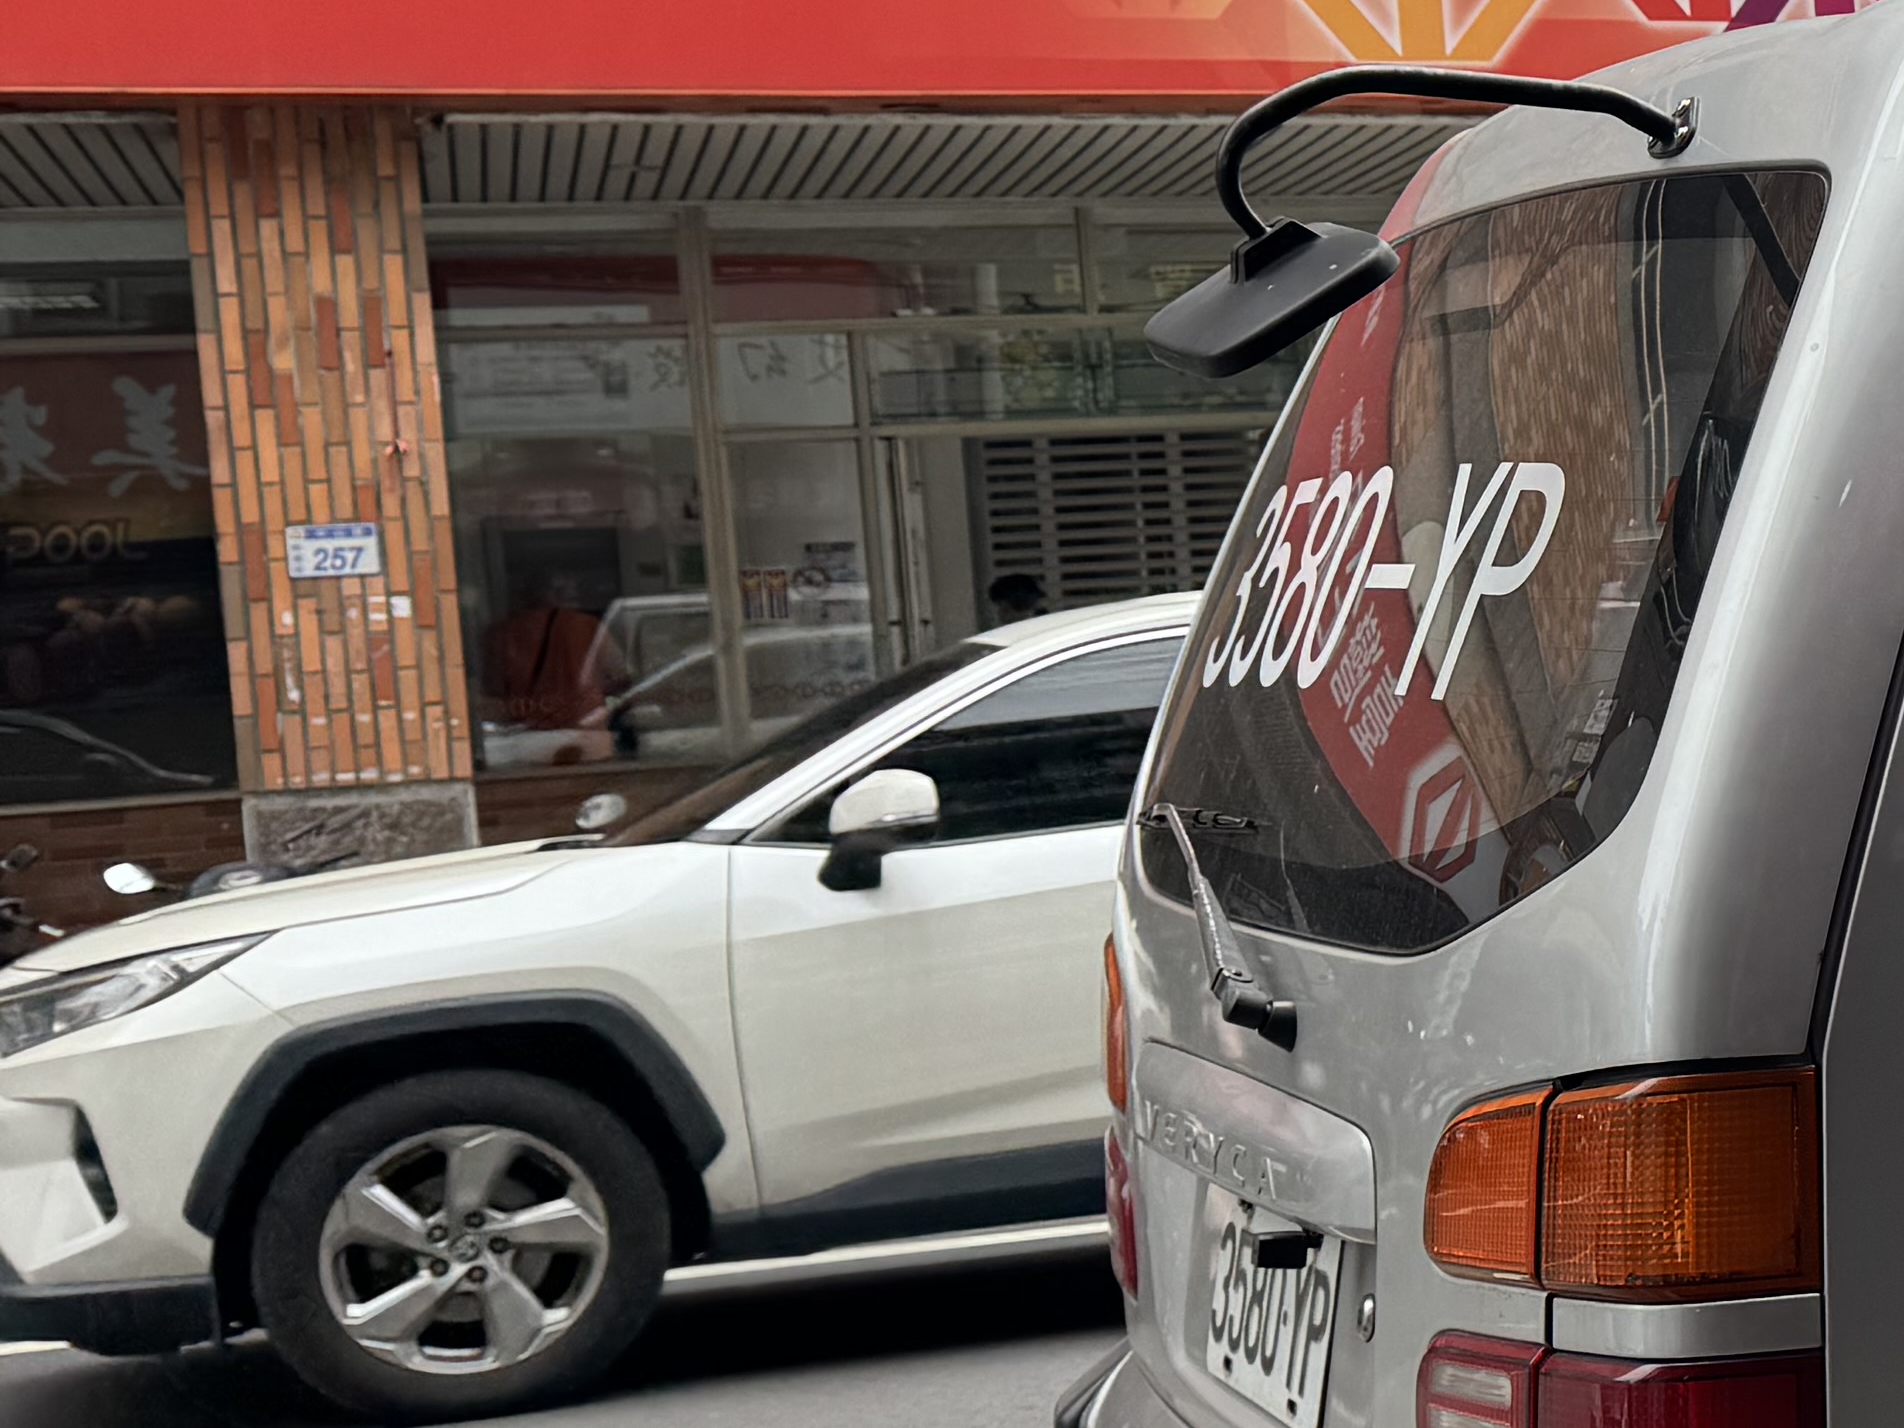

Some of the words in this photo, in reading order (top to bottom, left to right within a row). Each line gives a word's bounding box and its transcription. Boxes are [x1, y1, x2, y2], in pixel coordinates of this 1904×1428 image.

[313, 546, 364, 571] 257
[1203, 462, 1566, 701] 3580-YP
[1144, 1098, 1288, 1201] VERYCA
